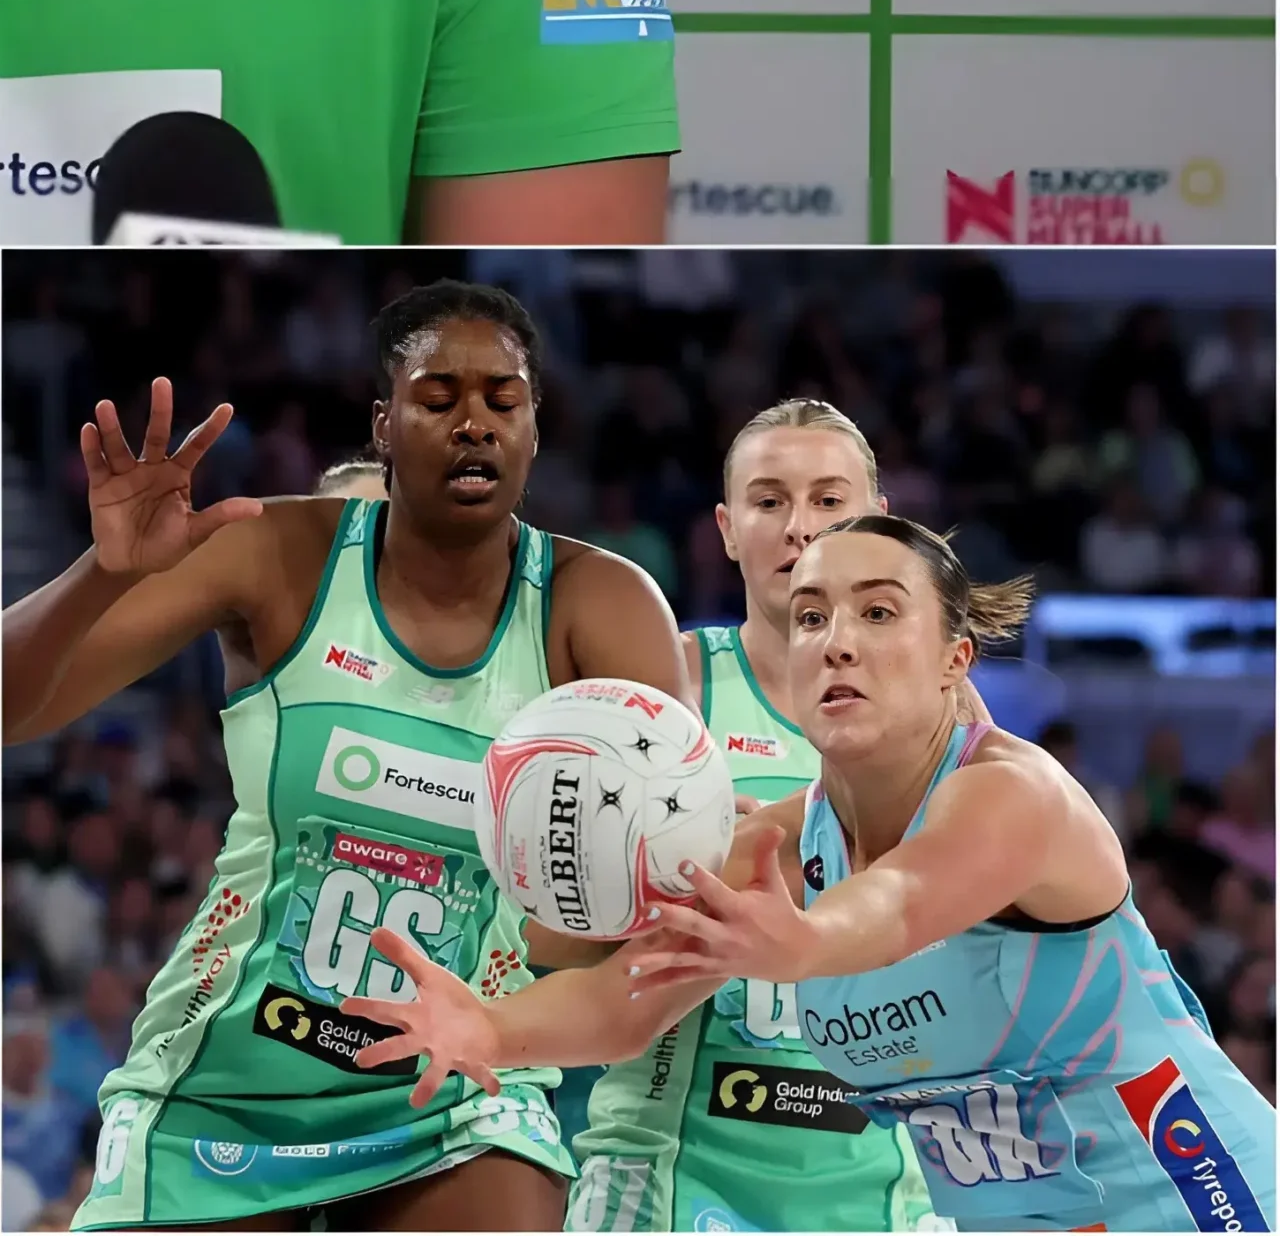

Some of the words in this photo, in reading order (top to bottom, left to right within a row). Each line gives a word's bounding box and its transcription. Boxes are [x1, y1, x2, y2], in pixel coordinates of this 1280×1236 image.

[384, 768, 475, 805] Fortescu
[338, 838, 408, 865] aware
[549, 769, 591, 931] GILBERT
[303, 868, 446, 1004] GS
[320, 1019, 360, 1042] Gold
[804, 988, 948, 1048] Cobram
[774, 1097, 823, 1119] Group
[776, 1082, 815, 1099] Gold
[1192, 1157, 1242, 1232] Tyrepo
